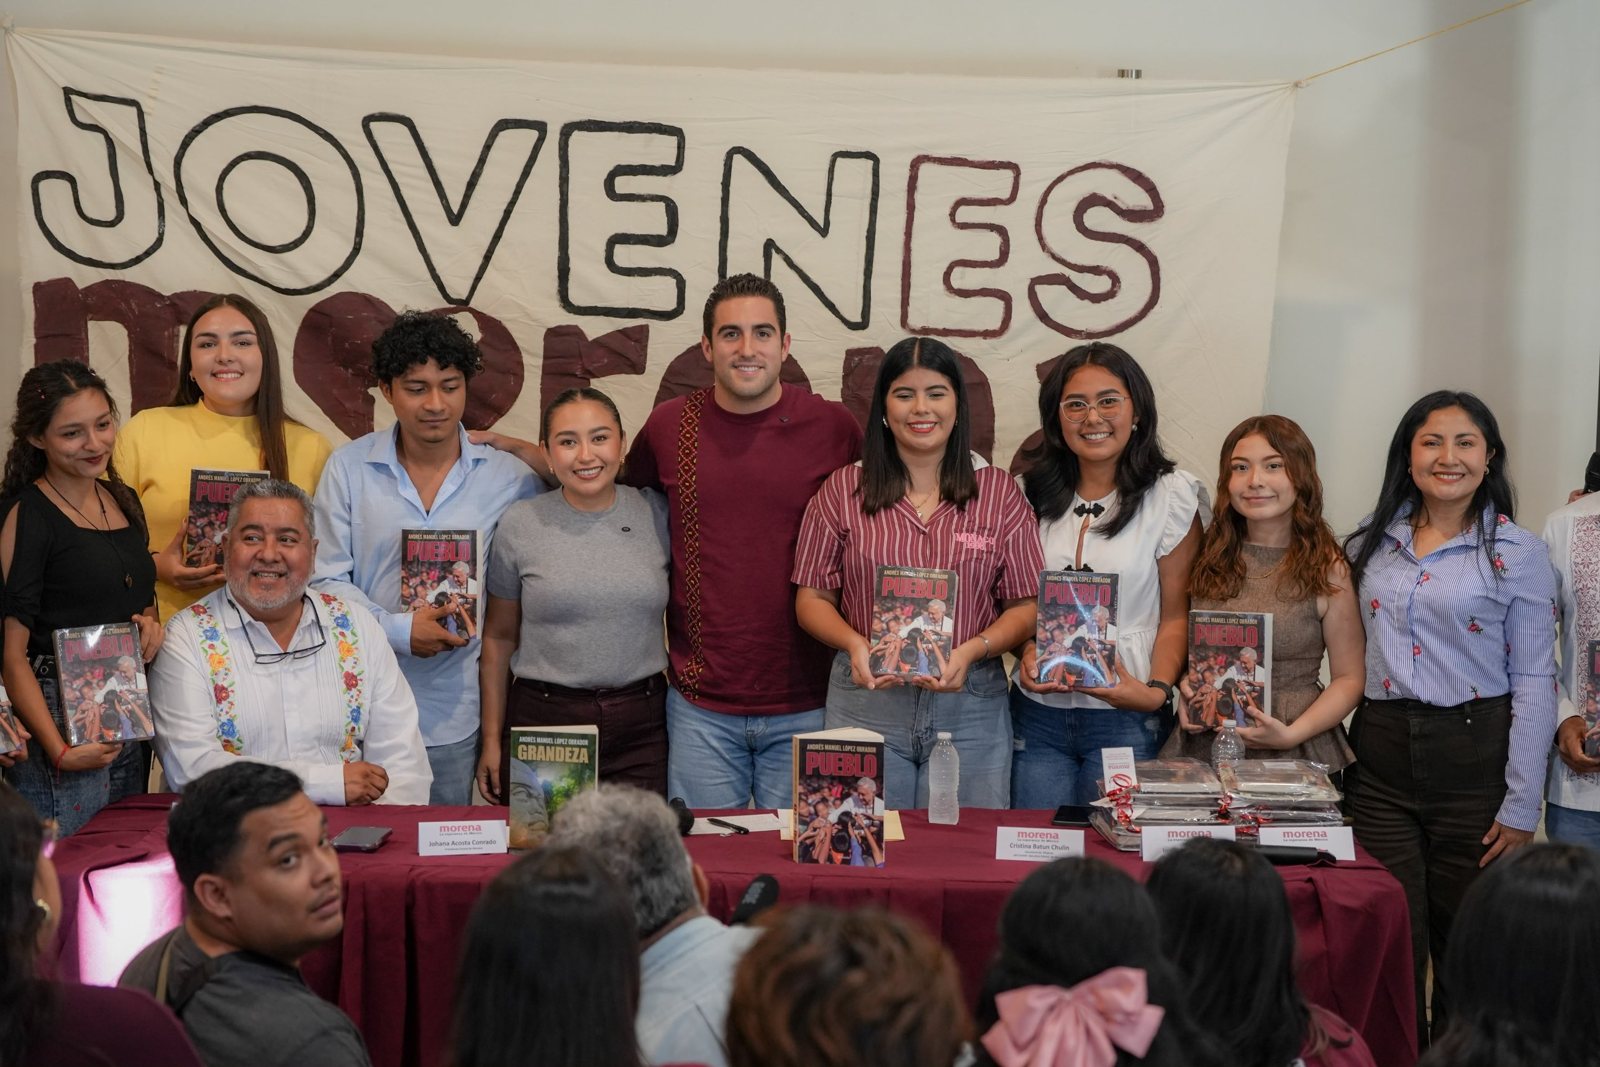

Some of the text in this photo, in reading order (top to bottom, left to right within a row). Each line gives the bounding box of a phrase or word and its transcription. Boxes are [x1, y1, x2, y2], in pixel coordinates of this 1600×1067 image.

[32, 86, 1164, 340] JOVENES
[407, 541, 471, 561] PUEBLO
[882, 576, 948, 599] PUEBLO
[1045, 582, 1111, 606] PUEBLO
[1194, 624, 1258, 647] PUEBLO
[64, 635, 135, 662] PUEBLO
[517, 744, 588, 764] GRANDEZA
[806, 752, 878, 778] PUEBLO
[440, 824, 482, 832] morena
[1018, 831, 1059, 839] morena
